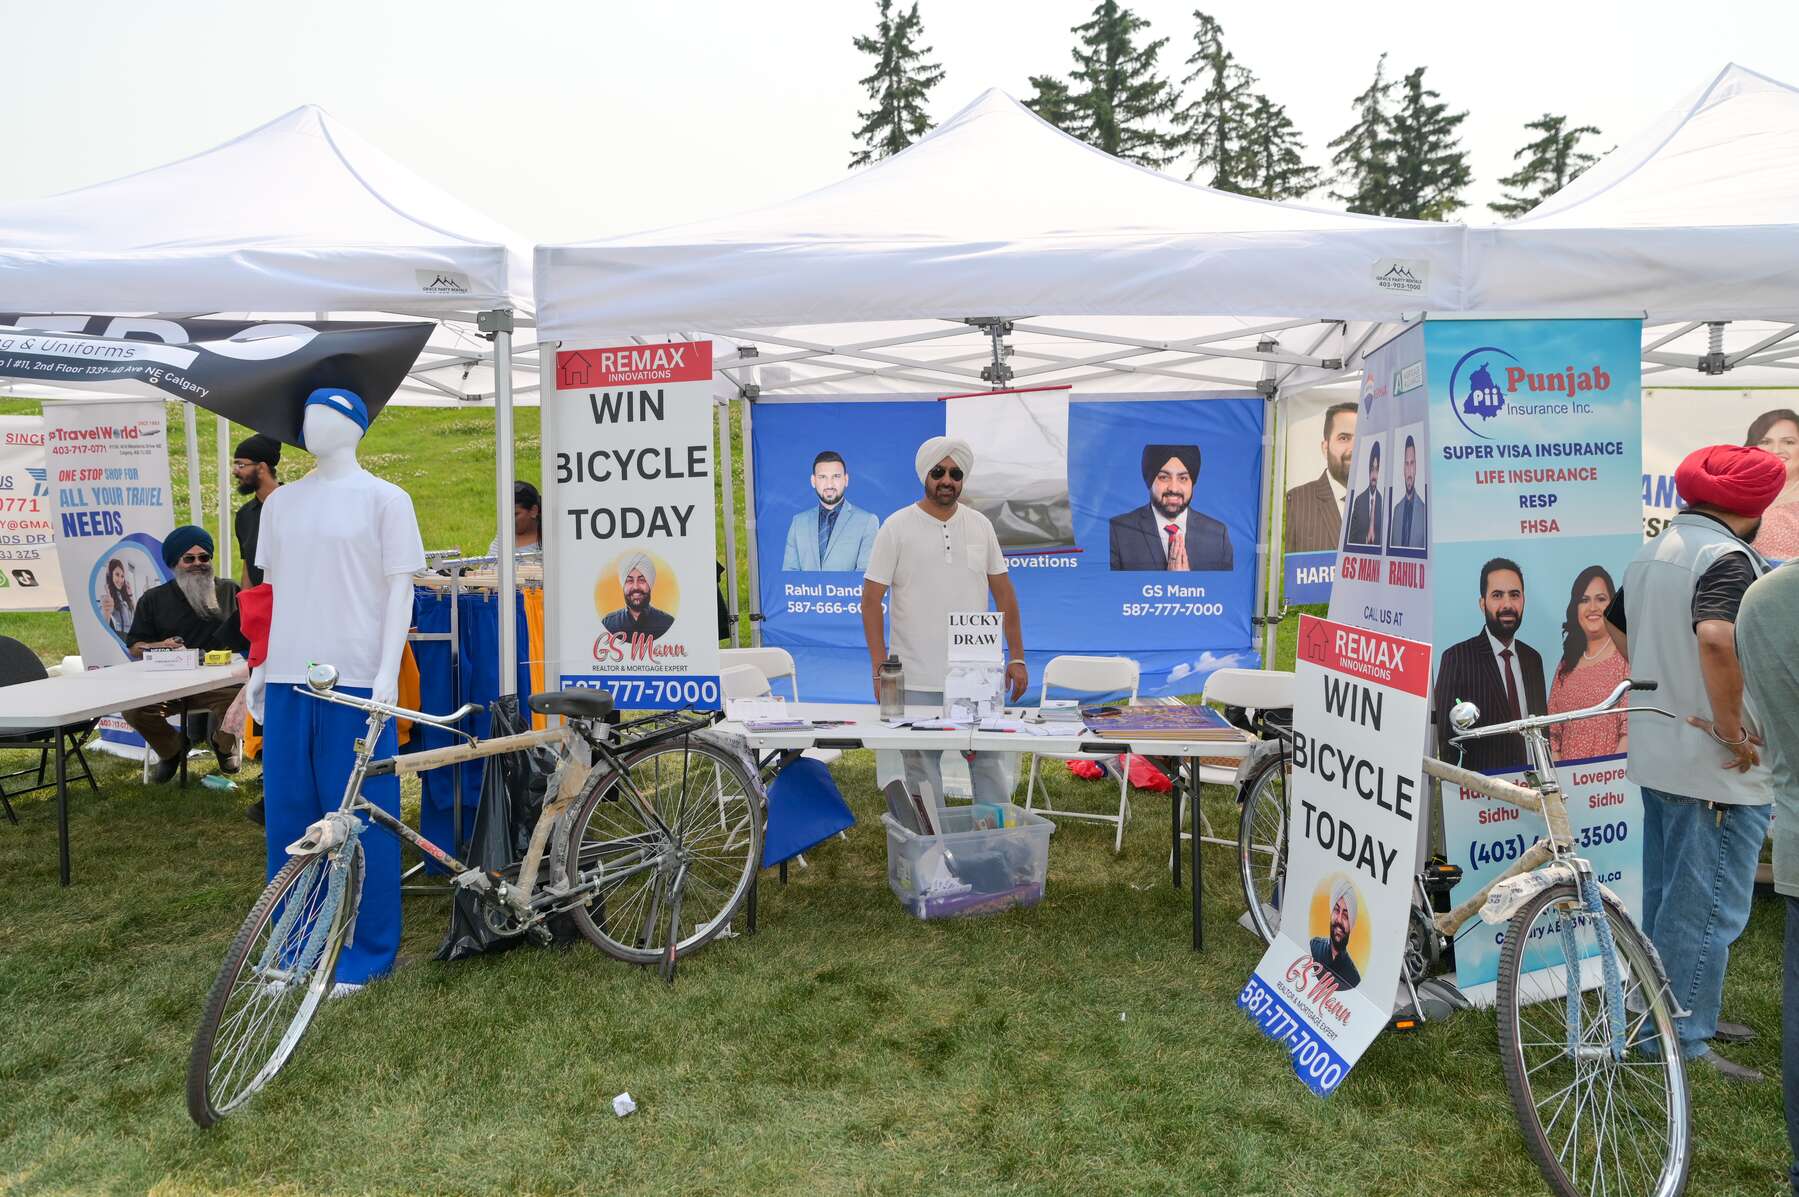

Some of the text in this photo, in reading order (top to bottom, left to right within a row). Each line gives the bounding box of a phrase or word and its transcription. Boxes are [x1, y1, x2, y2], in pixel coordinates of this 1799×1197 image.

[21, 338, 34, 351] &
[41, 339, 137, 359] Uniforms
[601, 347, 685, 373] REMAX
[33, 362, 52, 371] 2nd
[56, 363, 83, 374] Floor
[145, 366, 163, 378] NE
[165, 373, 209, 397] Calgary
[608, 370, 671, 382] INNOVATIONS
[1505, 366, 1611, 398] Punjab
[589, 389, 664, 425] WIN
[1507, 401, 1594, 415] Insurance Inc.
[1443, 442, 1623, 460] SUPER VISA INSURANCE
[59, 468, 139, 482] ONE STOP SHOP FOR
[557, 445, 708, 484] BICYCLE
[1475, 467, 1597, 485] LIFE INSURANCE
[60, 486, 163, 507] ALL YOUR TRAVEL
[1519, 493, 1558, 508] RESP
[61, 510, 123, 538] NEEDS
[568, 504, 695, 541] TODAY
[1520, 519, 1560, 534] FHSA
[26, 534, 46, 544] DR
[1342, 556, 1356, 580] GS
[1389, 560, 1417, 589] RAHUL
[785, 584, 822, 596] Rahul
[1142, 585, 1205, 597] GS Mann
[949, 615, 1001, 626] LUCKY
[1122, 603, 1223, 616] 587-777-7000
[1380, 609, 1392, 625] US
[1393, 611, 1403, 627] AT
[593, 631, 627, 663] GS
[954, 634, 998, 645] DRAW
[1335, 630, 1406, 673] REMAX
[1340, 657, 1391, 681] INNOVATIONS
[1324, 674, 1383, 732] WIN
[1293, 730, 1414, 821] BICYCLE
[1573, 768, 1627, 786] Lovepre
[1478, 792, 1624, 825] Sidhu Sidhu
[1302, 799, 1398, 885] TODAY
[1471, 834, 1525, 871] (403)
[1240, 979, 1342, 1089] 587-777-7000
